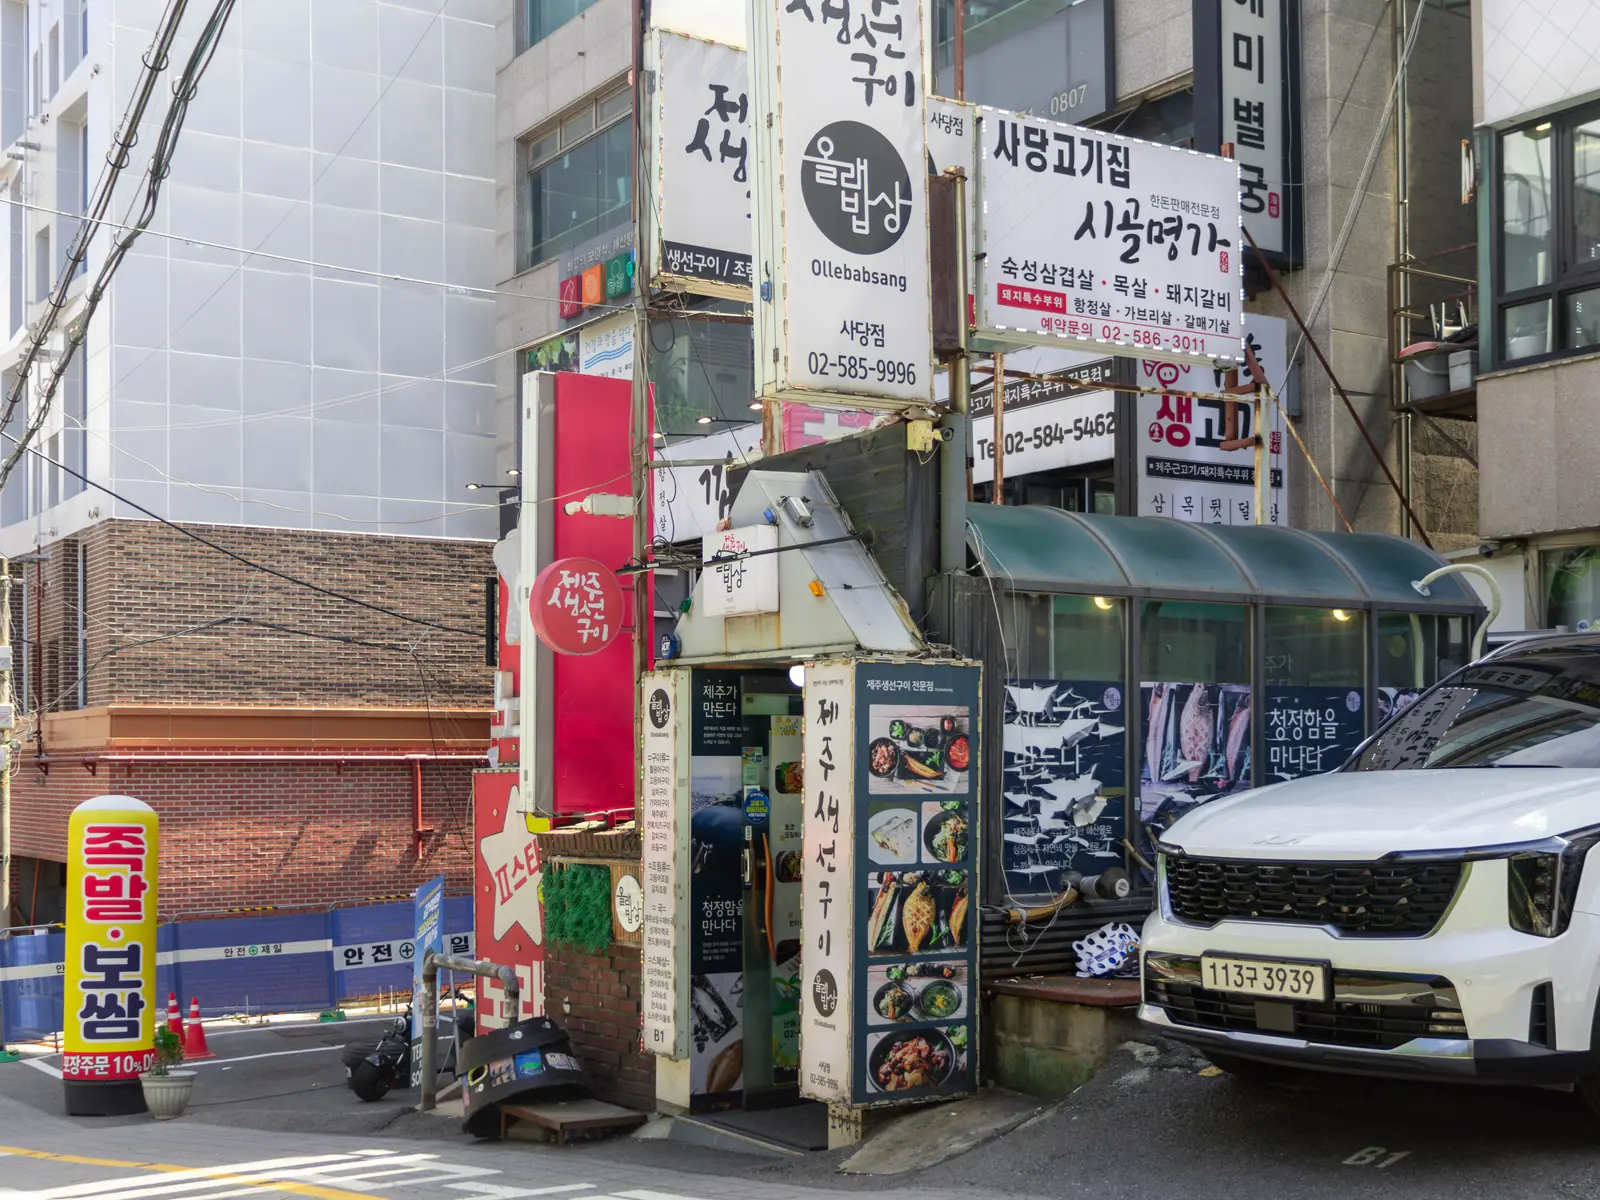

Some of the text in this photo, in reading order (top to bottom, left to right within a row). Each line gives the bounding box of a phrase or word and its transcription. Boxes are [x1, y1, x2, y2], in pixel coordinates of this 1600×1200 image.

[850, 53, 916, 107] 구이
[1051, 84, 1087, 116] 0807
[931, 111, 964, 137] 사당점
[993, 119, 1132, 190] 사당고기집
[1149, 193, 1221, 220] 한돈판매전문점
[1074, 197, 1232, 265] 시골명가
[668, 248, 720, 275] 생선구이
[810, 258, 908, 293] Ollebabsang
[1000, 255, 1232, 313] 숙성삼겹살 목살 돼지갈비
[1002, 287, 1231, 335] 돼지특수부위 항정살 가브리살 갈매기살
[839, 320, 885, 348] 사당점
[1040, 316, 1207, 354] 예약문의 02-586-3011
[808, 350, 917, 386] 02-585-9996
[557, 569, 604, 597] 제주
[547, 587, 605, 621] 생선
[577, 619, 609, 644] 구이
[702, 684, 738, 700] 제주가
[867, 679, 911, 691] 제주생선구이
[912, 680, 934, 692] 전문점
[702, 701, 738, 719] 만든다
[1269, 708, 1340, 741] 청정함을
[1270, 745, 1323, 777] 만나다
[815, 698, 840, 957] 제주생선구이
[702, 898, 743, 919] 청정함을
[702, 918, 737, 936] 만나다
[1208, 961, 1316, 995] 113구 3939
[653, 1028, 665, 1043] B1
